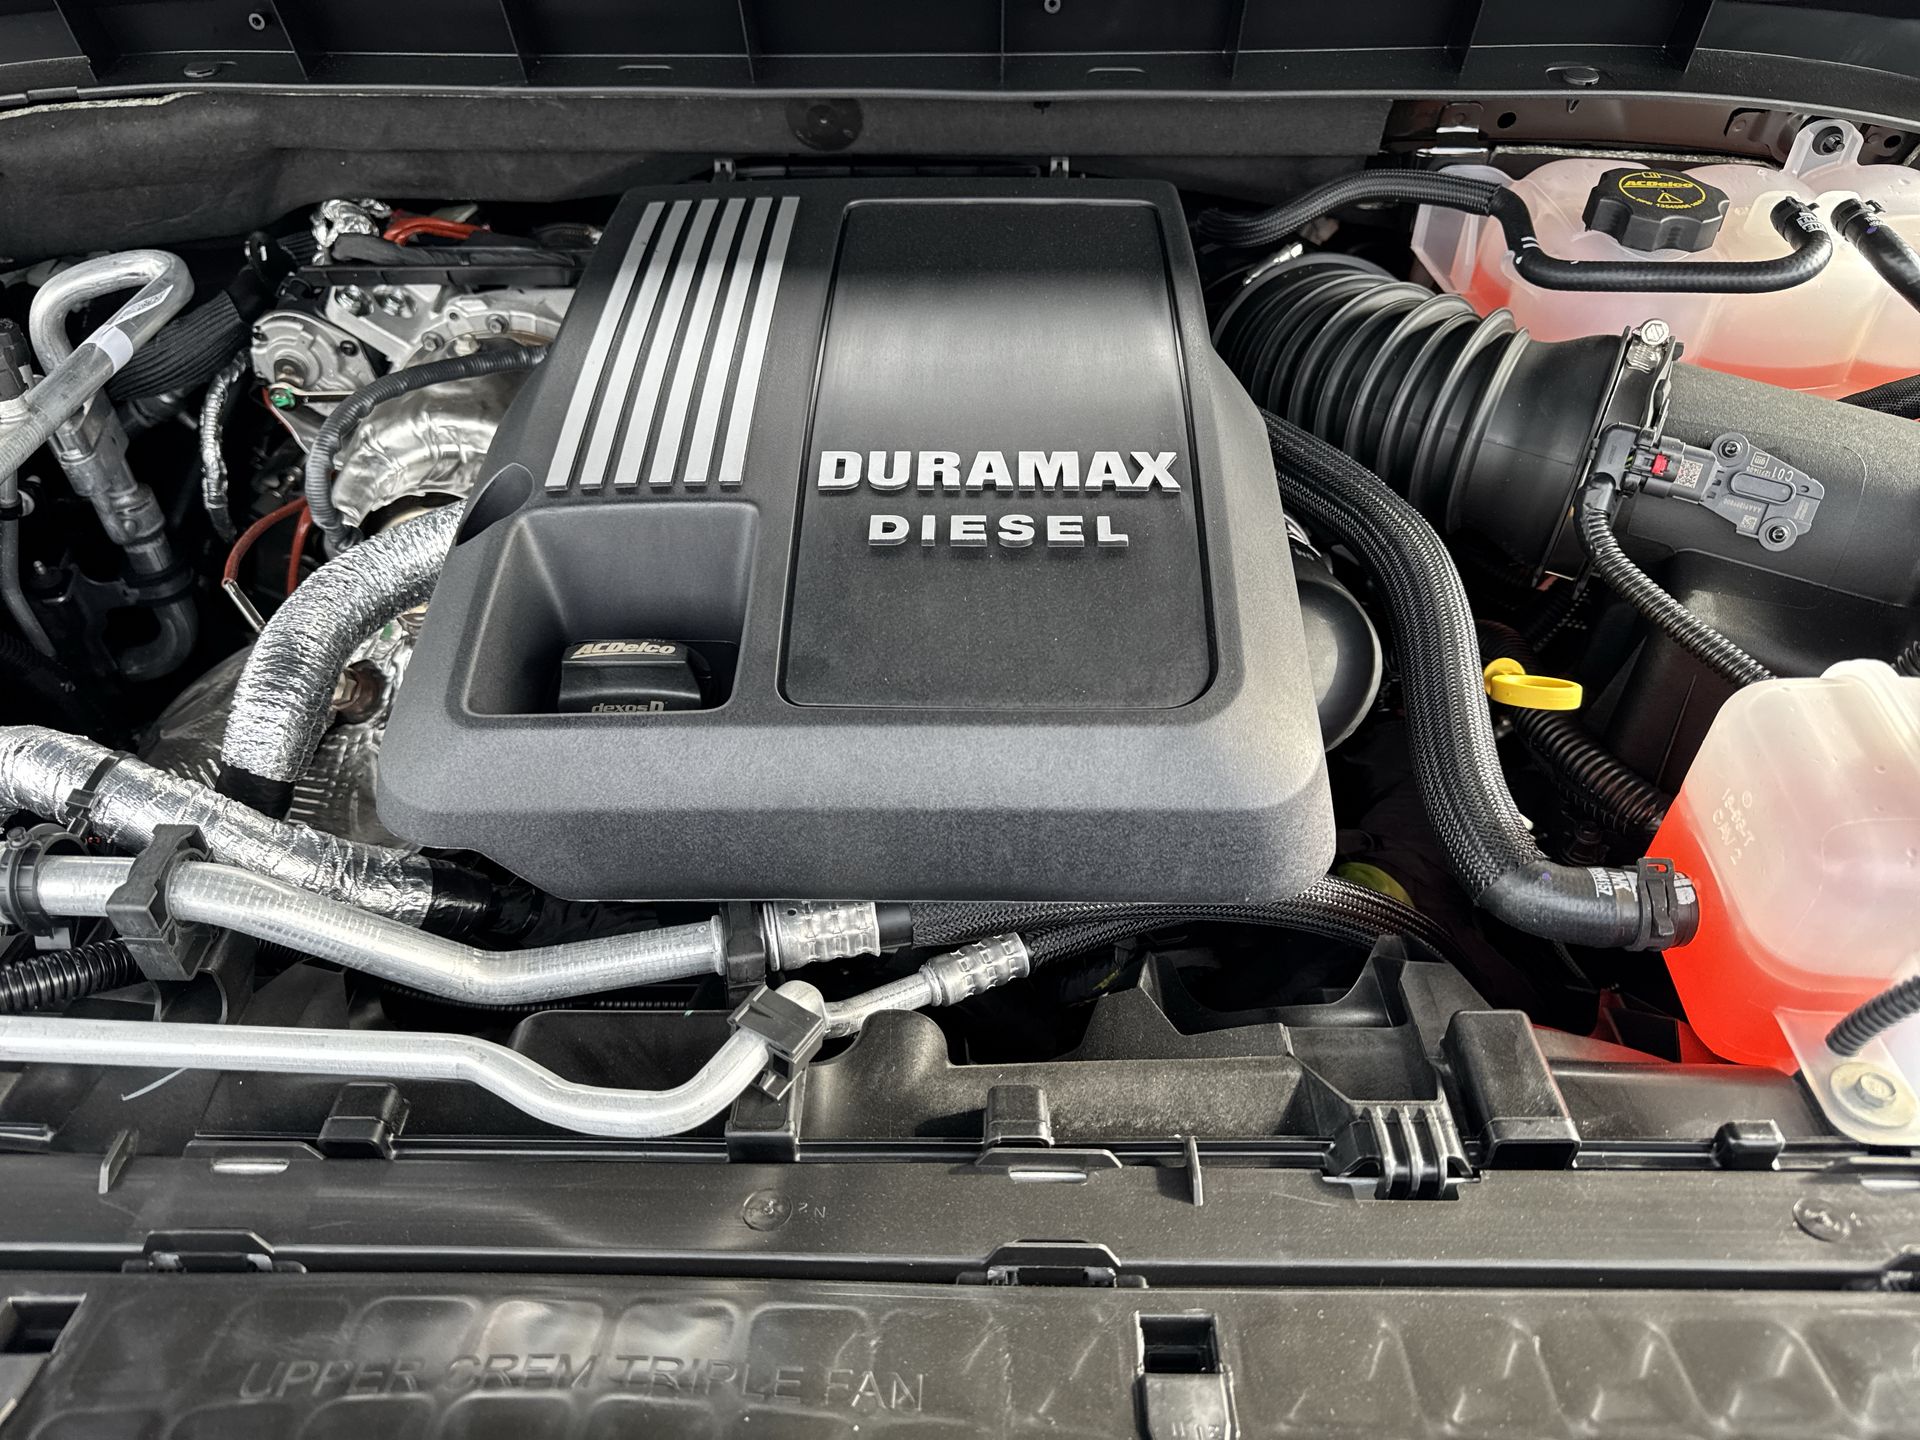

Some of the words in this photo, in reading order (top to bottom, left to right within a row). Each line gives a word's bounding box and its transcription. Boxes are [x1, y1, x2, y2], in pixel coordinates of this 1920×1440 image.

[1623, 180, 1694, 189] ACDelco
[818, 450, 1181, 492] DURAMAX
[868, 514, 1129, 547] DIESEL
[572, 642, 676, 657] ACDelco
[239, 1359, 426, 1400] UPPER
[609, 1354, 804, 1400] TRIPLE
[824, 1368, 923, 1412] FAN
